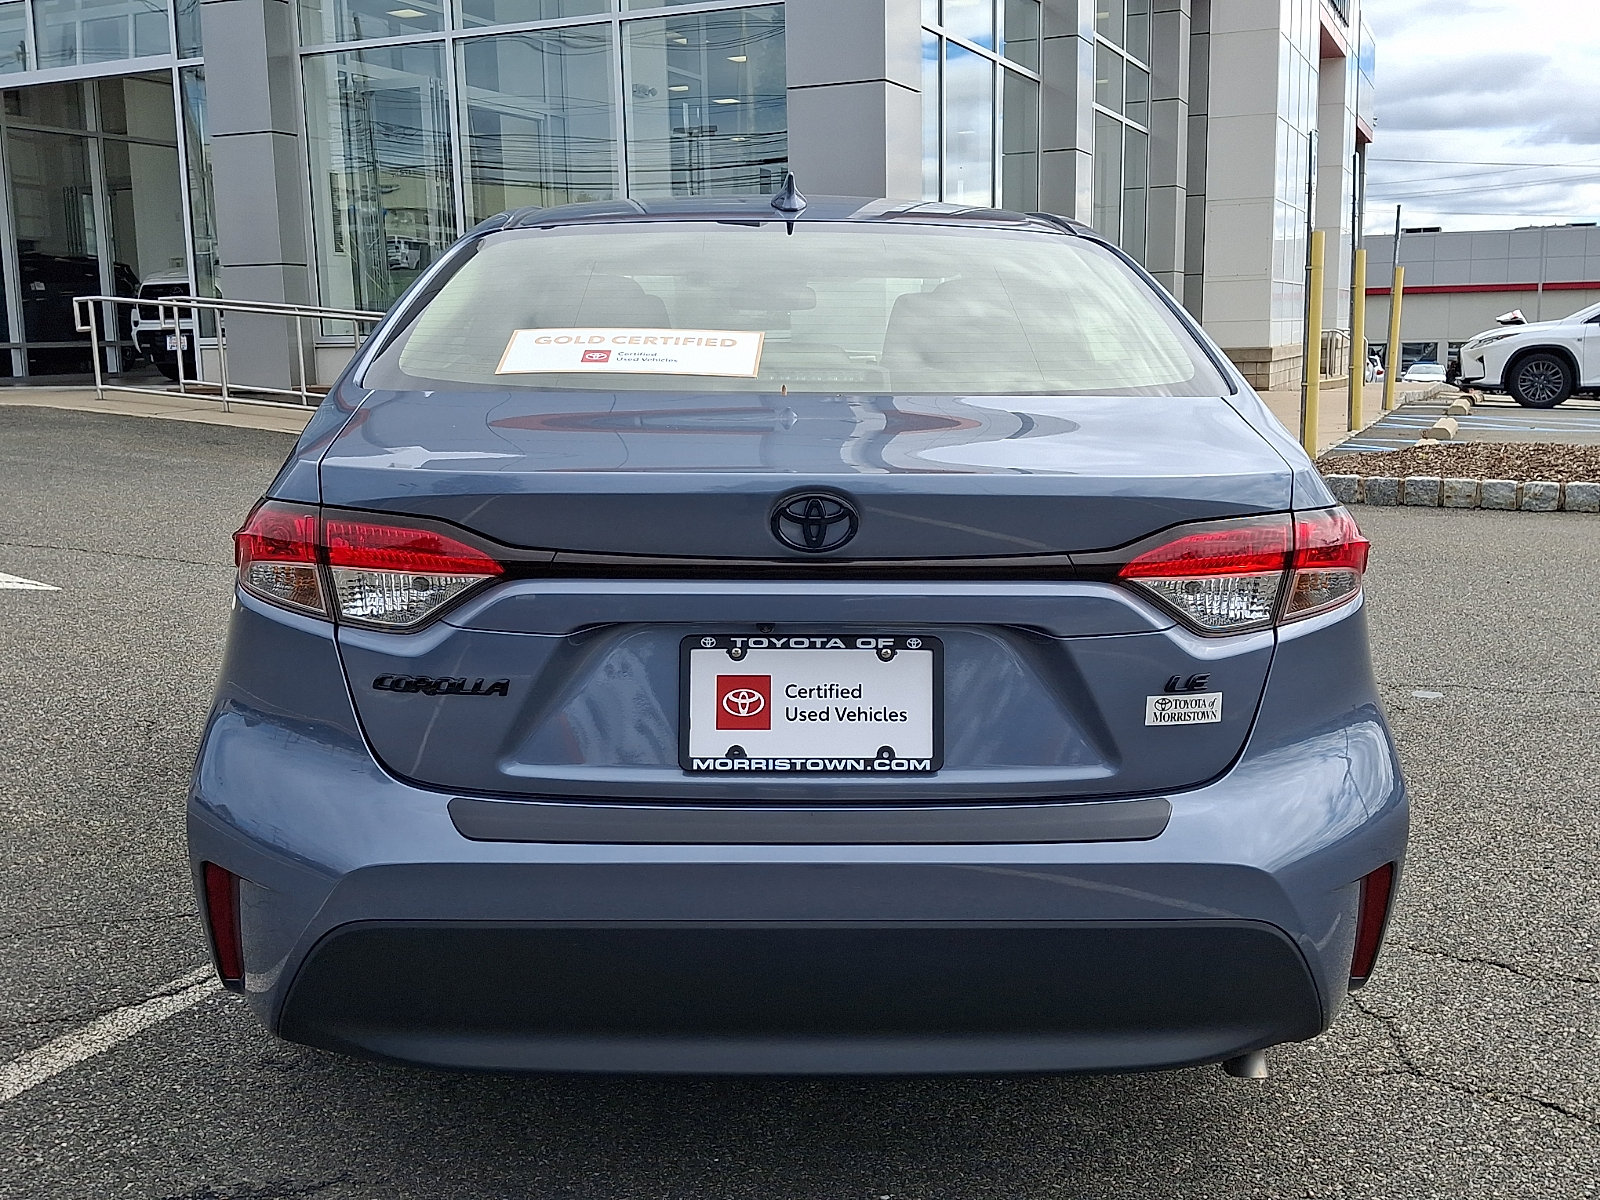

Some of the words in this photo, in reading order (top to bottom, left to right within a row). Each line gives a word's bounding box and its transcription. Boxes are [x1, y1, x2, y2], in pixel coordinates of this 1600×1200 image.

[534, 335, 606, 345] GOLD
[611, 335, 738, 348] CERTIFIED
[730, 637, 846, 649] TOYOTA
[855, 638, 895, 649] OF
[372, 672, 511, 697] COROLLA
[1164, 672, 1210, 692] LE
[785, 683, 862, 699] Certified
[1173, 699, 1206, 709] TOYOTA
[1209, 698, 1217, 709] of
[785, 706, 830, 722] Used
[835, 706, 908, 722] Vehicles
[1152, 710, 1217, 722] MORRISTOWN
[692, 758, 931, 771] MORRISTOWN.COM
